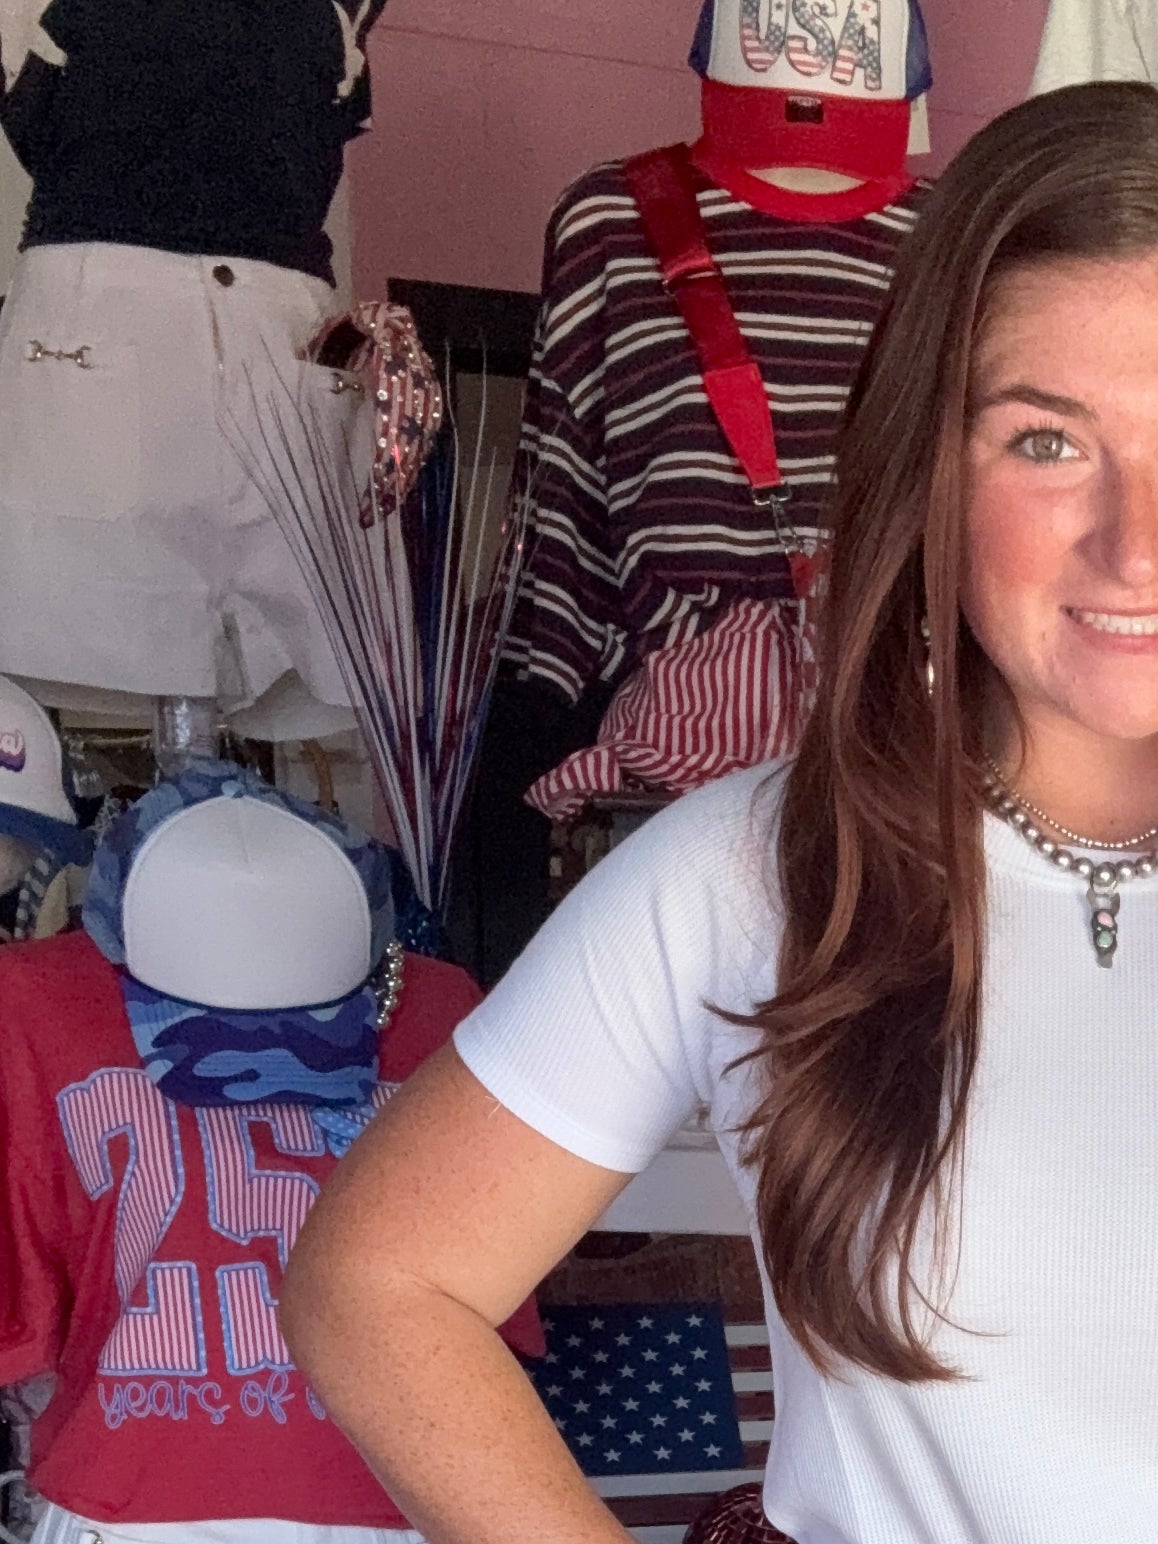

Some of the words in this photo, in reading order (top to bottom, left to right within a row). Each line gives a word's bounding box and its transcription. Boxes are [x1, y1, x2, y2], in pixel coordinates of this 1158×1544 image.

[739, 0, 882, 91] USA
[98, 1379, 231, 1429] years
[240, 1371, 296, 1425] of
